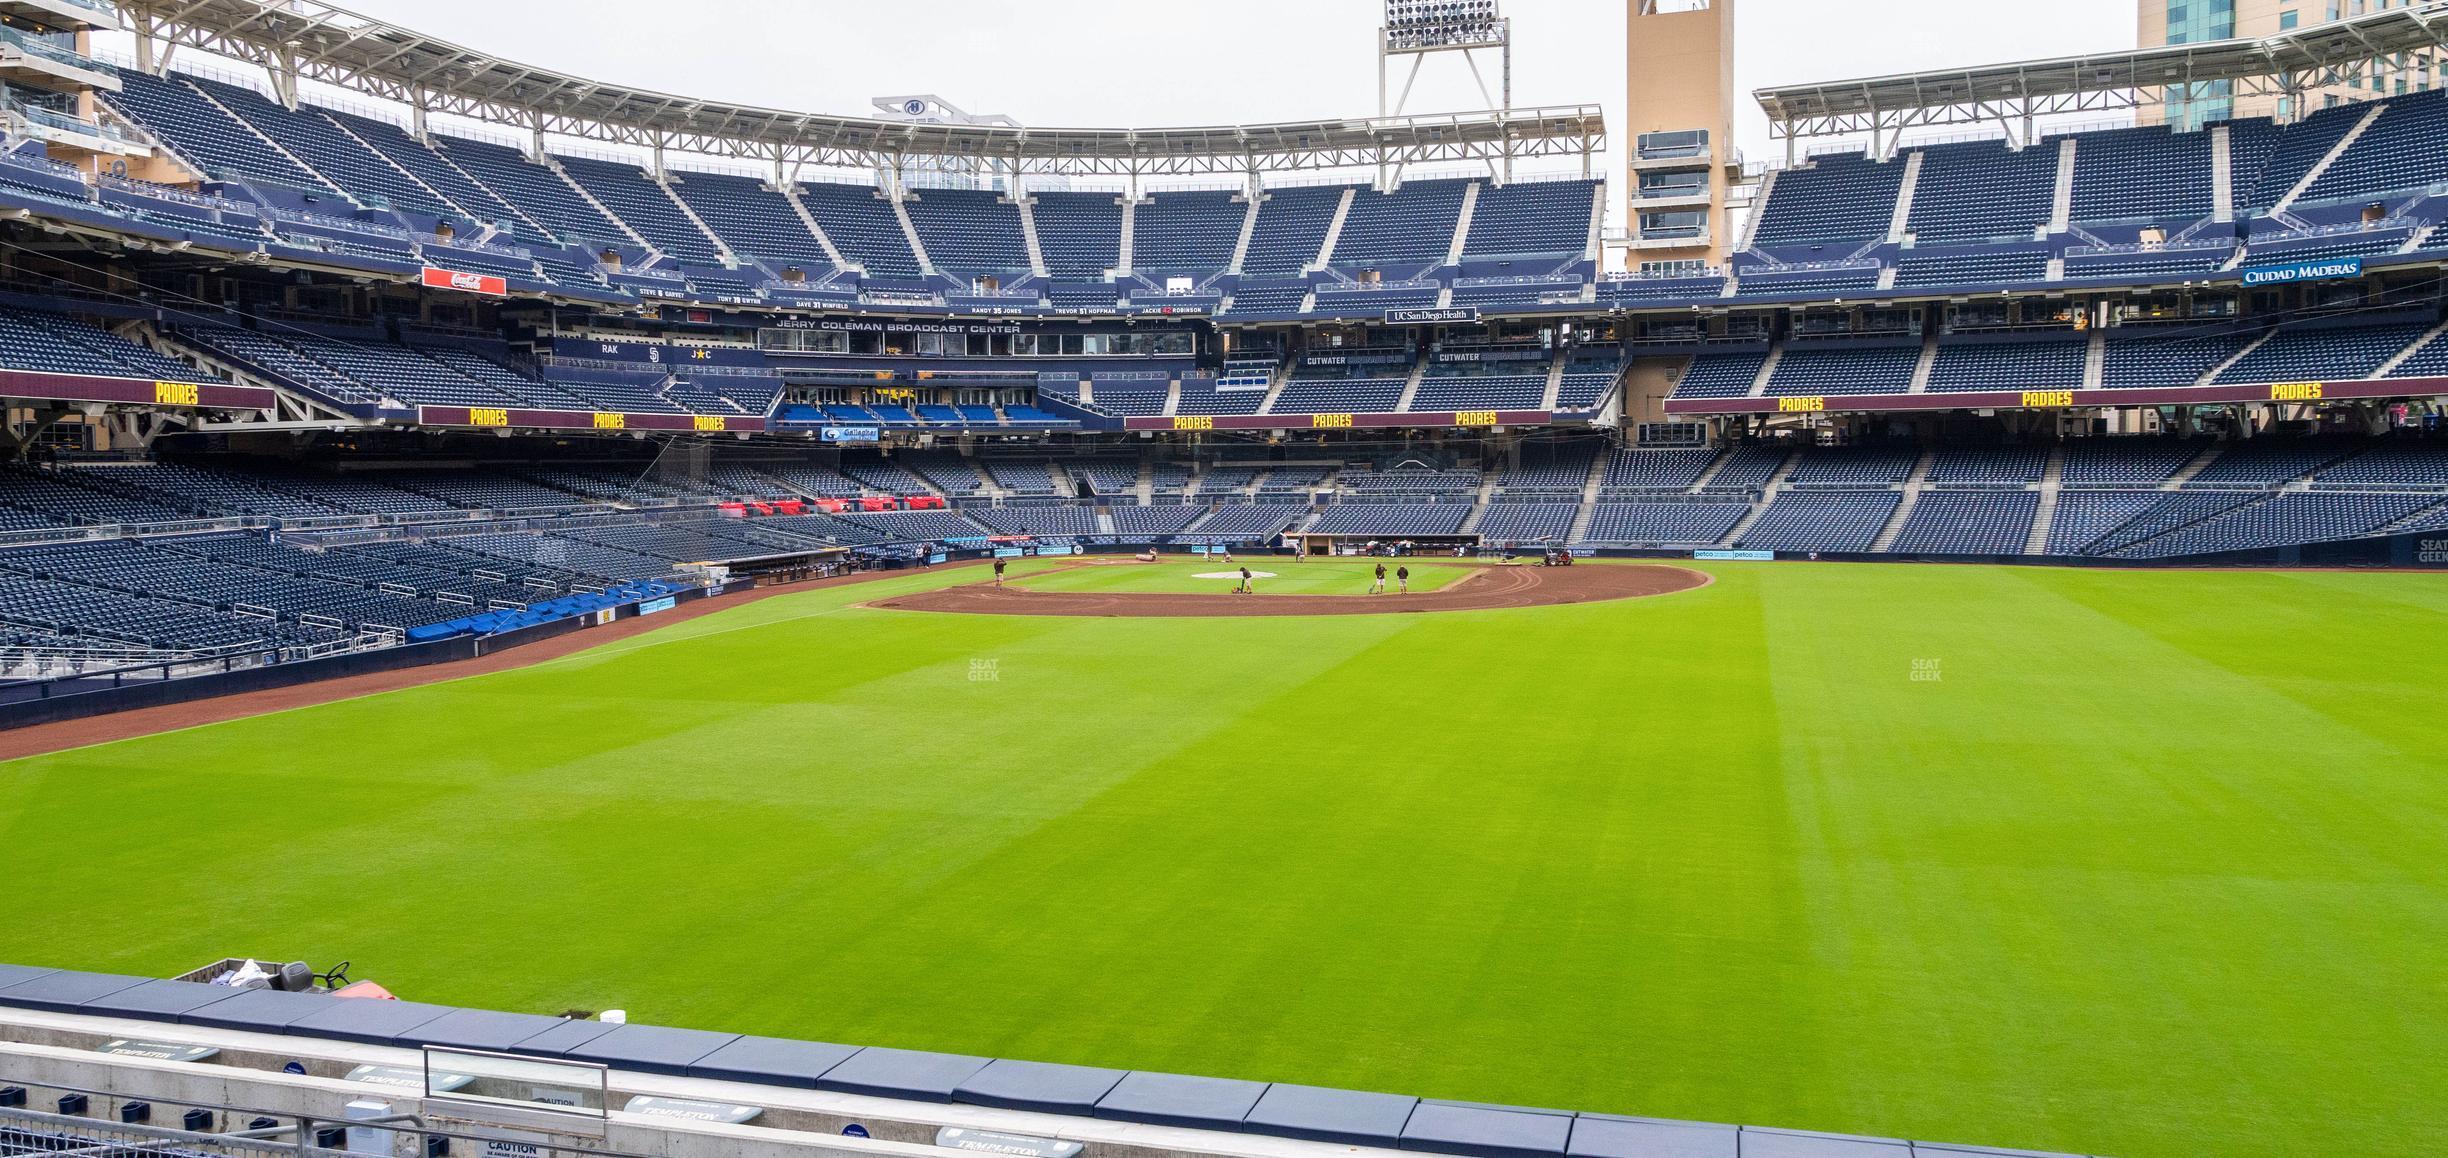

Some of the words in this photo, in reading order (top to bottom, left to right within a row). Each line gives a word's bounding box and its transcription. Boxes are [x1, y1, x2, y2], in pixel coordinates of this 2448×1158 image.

[2245, 269, 2296, 283] CIUDAD
[2298, 263, 2357, 279] MADERAS
[1395, 311, 1407, 321] UC
[1407, 311, 1421, 320] San
[1421, 310, 1442, 321] Diego
[1443, 310, 1467, 319] Health
[776, 320, 816, 329] JERRY
[821, 321, 882, 331] COLEMAN
[887, 323, 965, 333] BROADCAST
[970, 324, 1021, 334] CENTER
[602, 344, 618, 354] RAK
[1307, 356, 1346, 365] CUTWATER
[1440, 353, 1480, 362] CUTWATER
[155, 381, 198, 404] PADRES
[2271, 382, 2321, 399] PADRES
[1778, 397, 1824, 411] PADRES
[2022, 391, 2072, 406] PADRES
[470, 408, 507, 425] PADRES
[594, 413, 624, 428] PADRES
[694, 417, 724, 430] PADRES
[1174, 415, 1212, 428] PADRES
[1312, 414, 1352, 427] PADRES
[1455, 411, 1496, 425] PADRES
[488, 1141, 537, 1155] CAUTION
